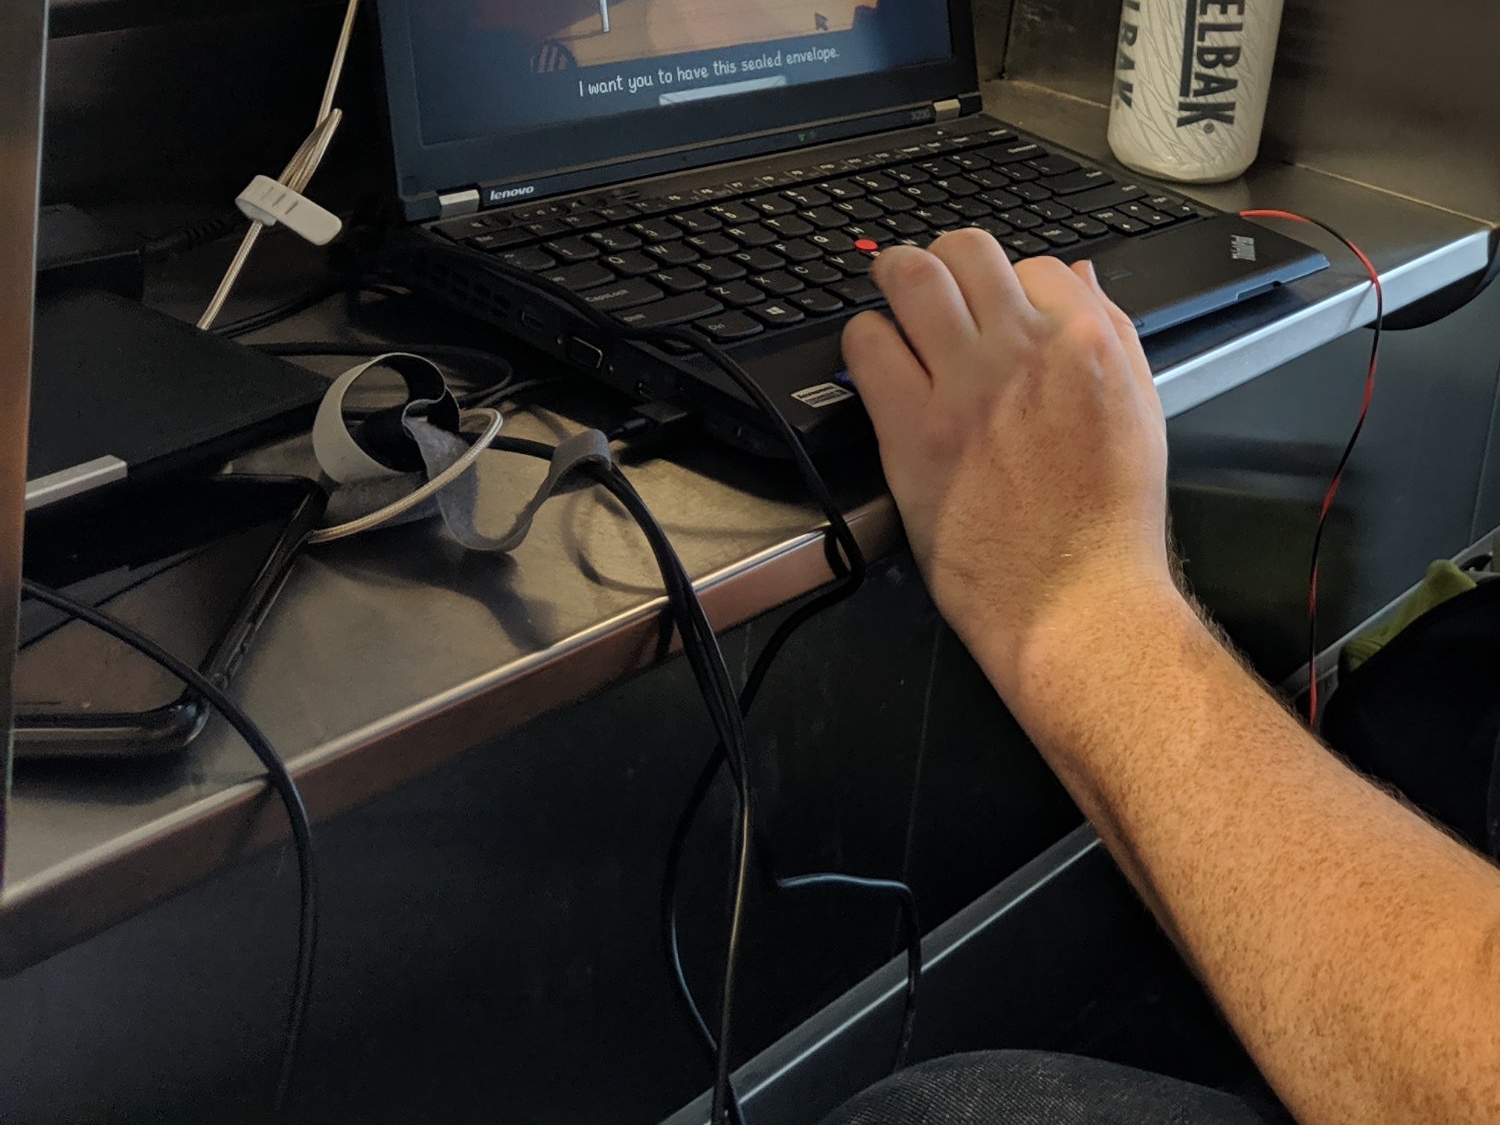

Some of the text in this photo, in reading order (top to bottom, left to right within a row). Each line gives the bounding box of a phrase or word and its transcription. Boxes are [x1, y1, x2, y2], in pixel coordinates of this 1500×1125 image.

[579, 45, 840, 97] I want you to have this sealed envelope.
[489, 185, 535, 201] lenovo
